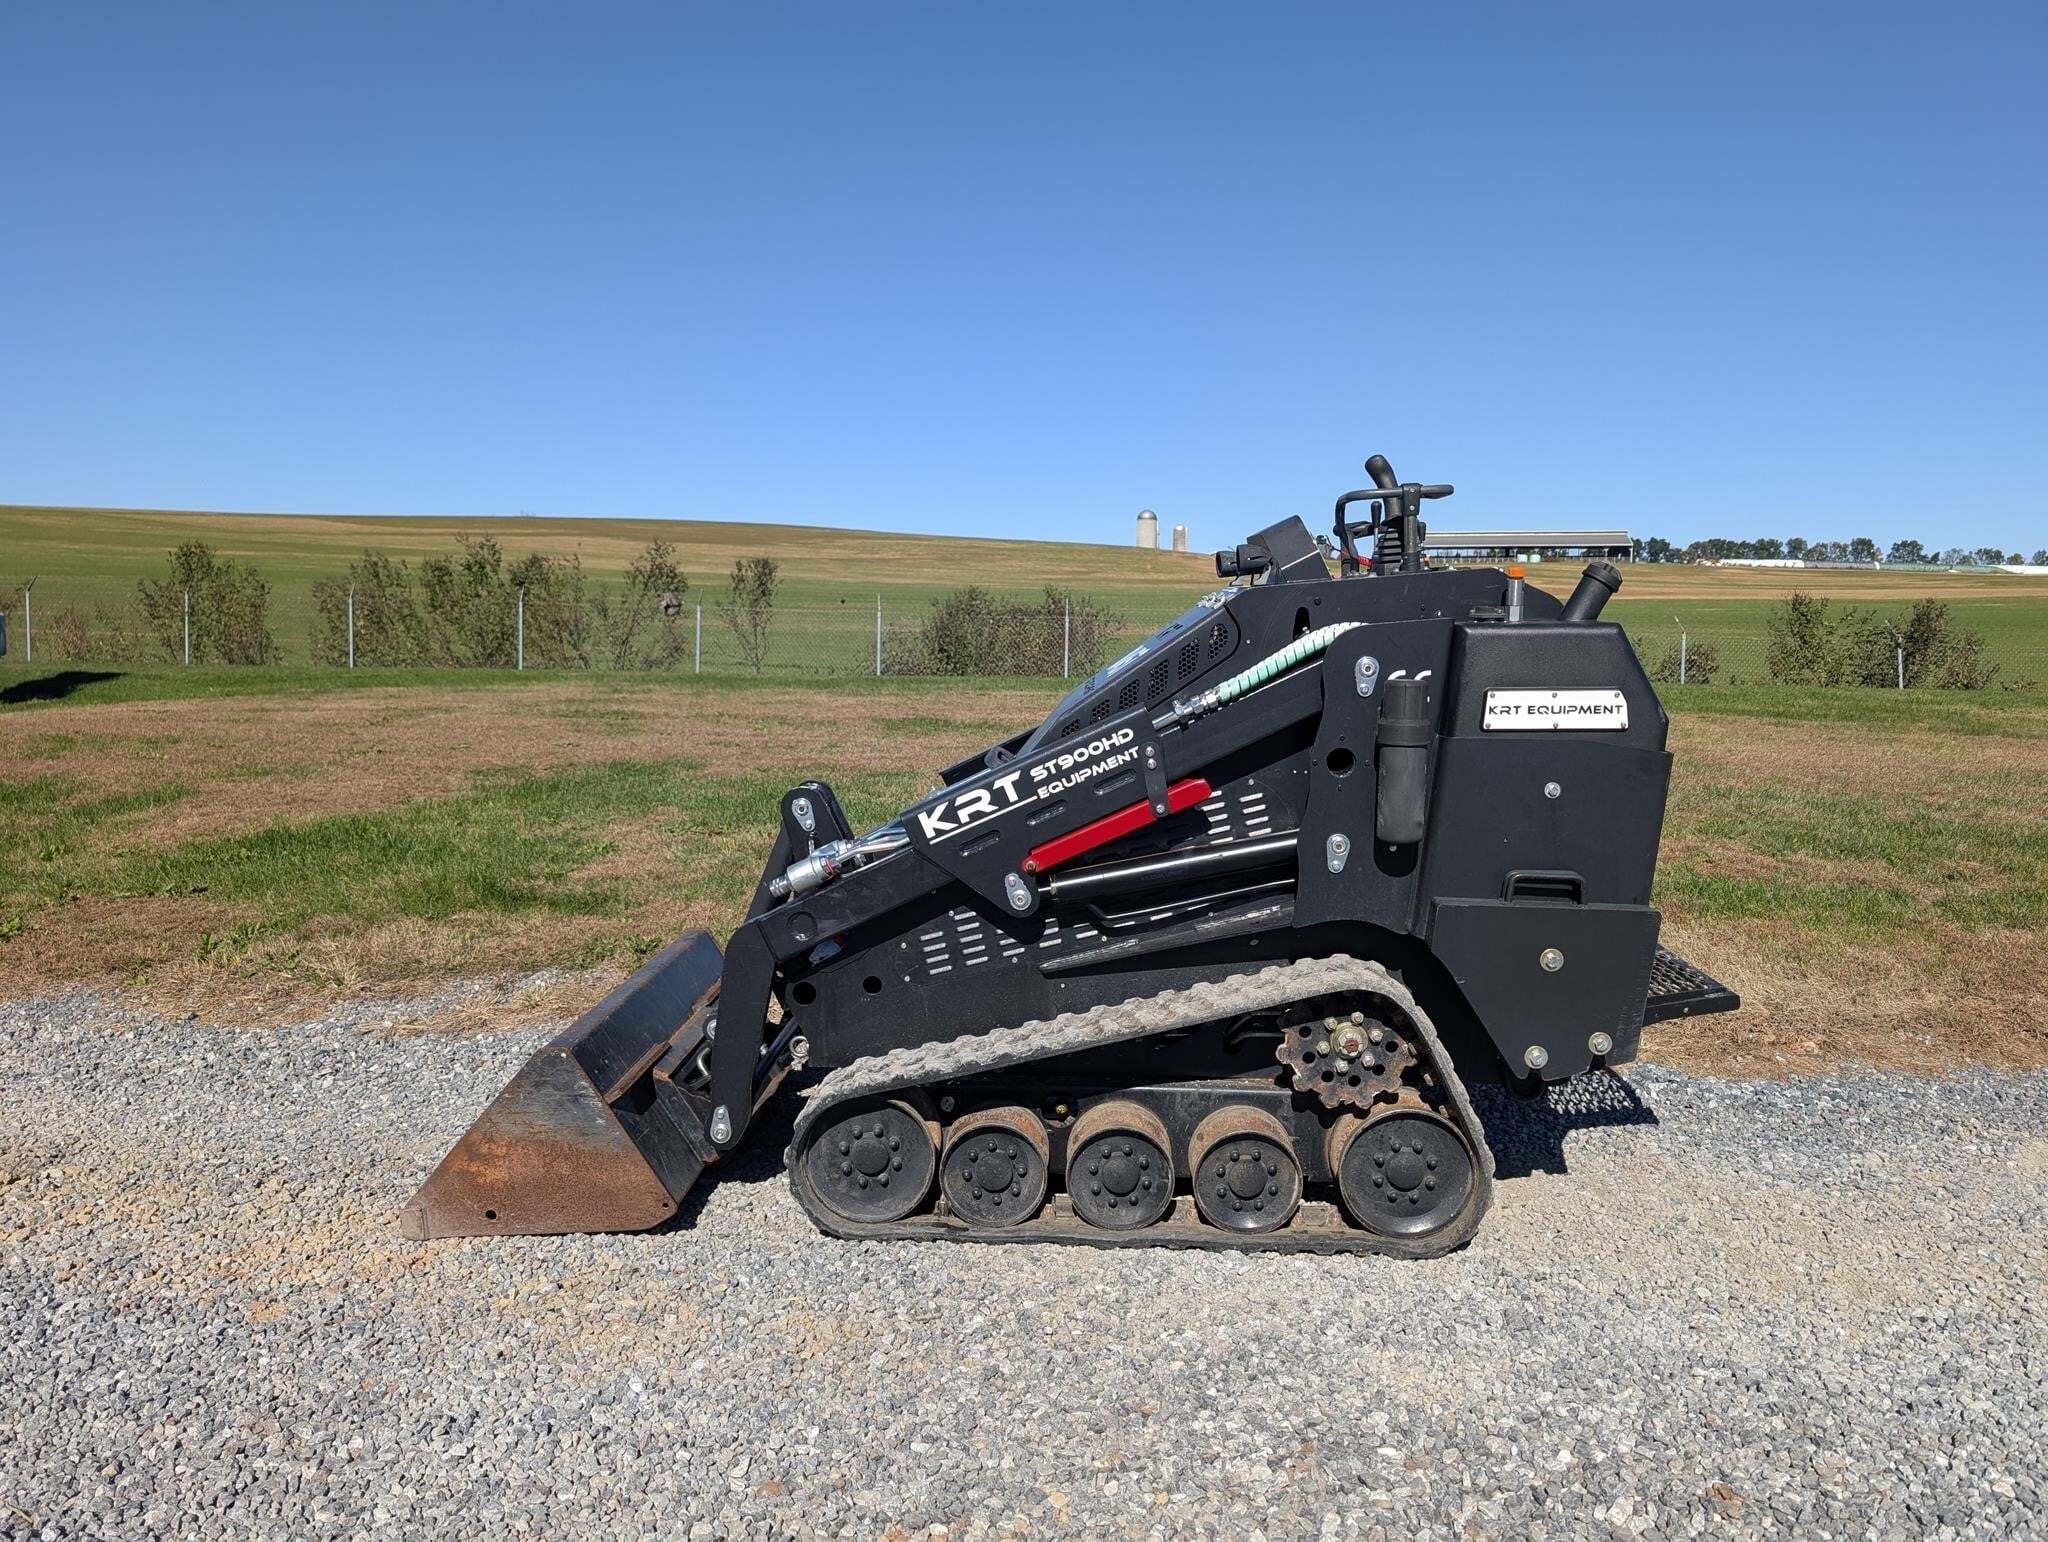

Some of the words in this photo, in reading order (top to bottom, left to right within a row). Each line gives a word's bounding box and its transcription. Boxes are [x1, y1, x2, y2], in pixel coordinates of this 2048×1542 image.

[1488, 705, 1522, 715] KRT
[1527, 705, 1623, 715] EQUIPMENT
[917, 770, 1022, 839] KRT
[1029, 728, 1135, 783] ST900HD
[1036, 745, 1139, 800] EQUIPMENT
